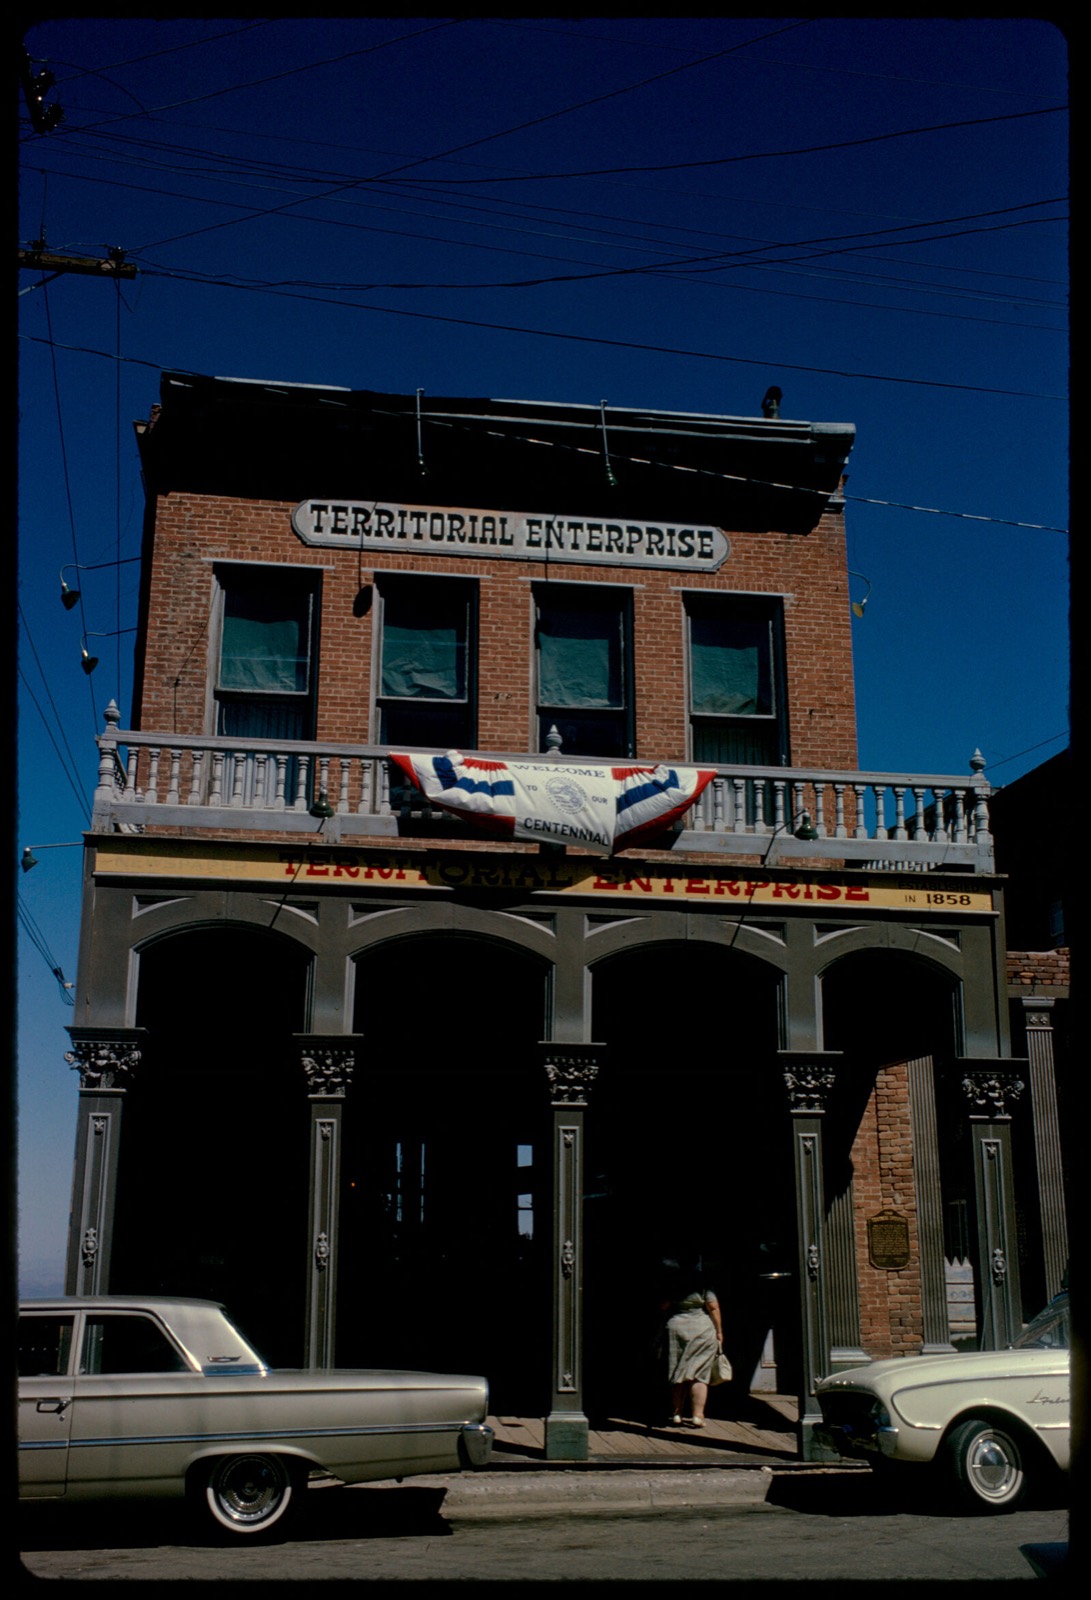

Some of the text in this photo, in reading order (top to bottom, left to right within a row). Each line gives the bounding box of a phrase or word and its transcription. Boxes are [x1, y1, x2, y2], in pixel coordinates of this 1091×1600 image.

[309, 503, 715, 560] TERRITORIAL ENTERPRISE
[512, 764, 606, 778] WELCOME
[526, 784, 538, 792] TO
[591, 795, 608, 805] OUR
[523, 817, 609, 847] CENTENNIAL
[279, 852, 870, 902] TERRITORIAL ENTERPRISE
[904, 893, 972, 906] IN 1858
